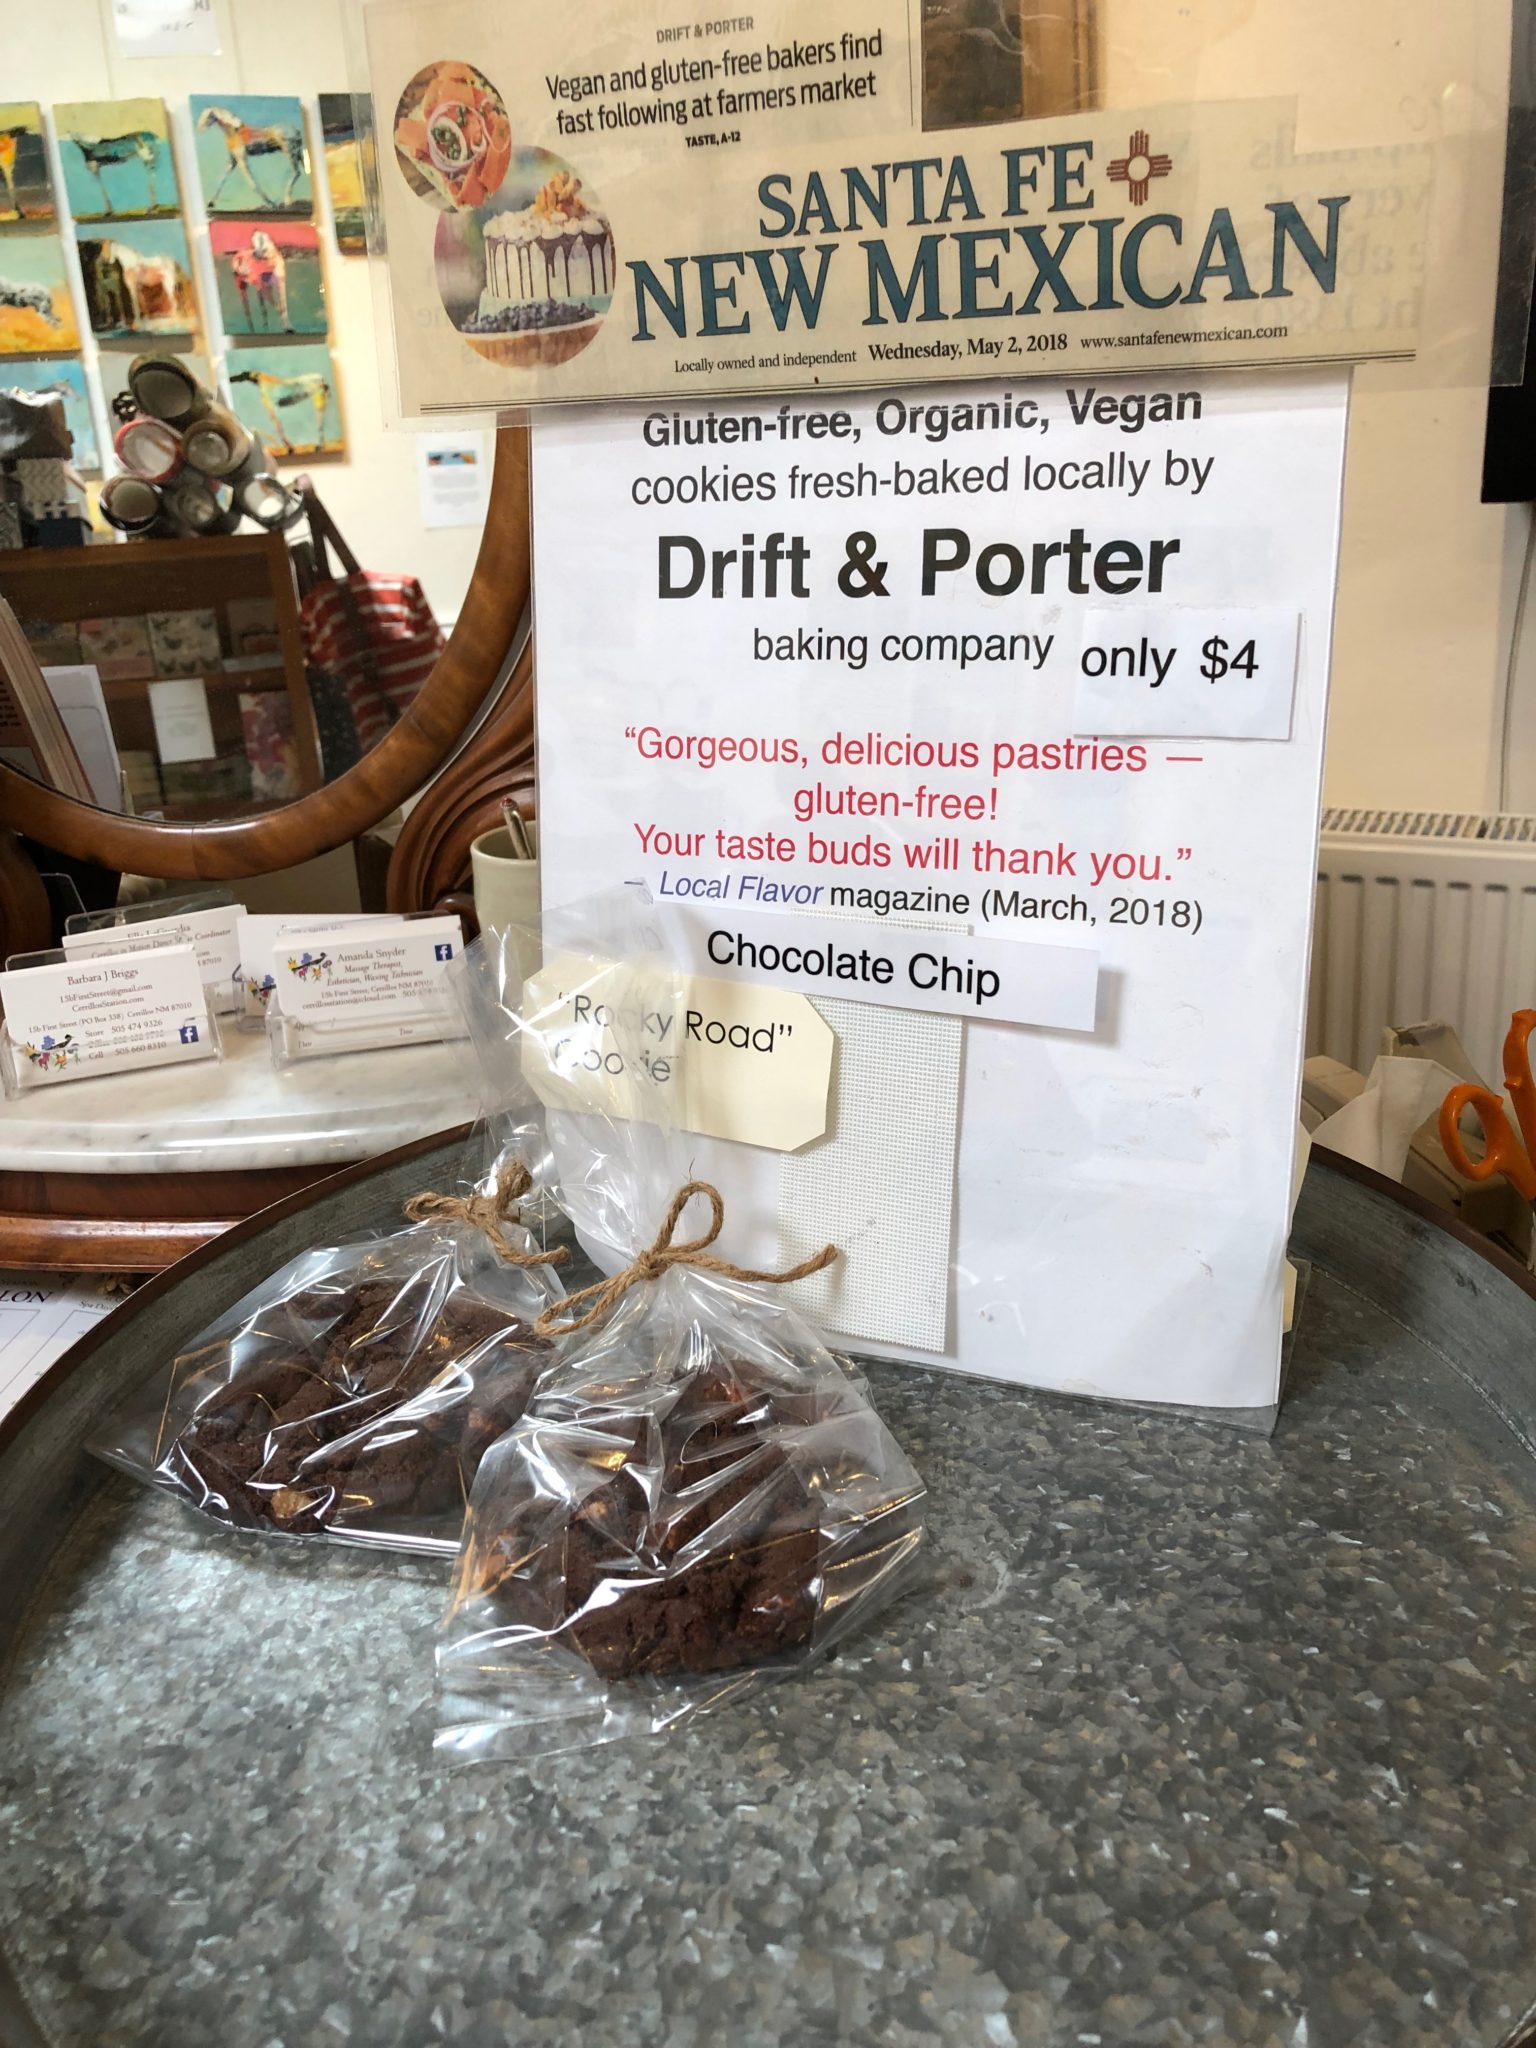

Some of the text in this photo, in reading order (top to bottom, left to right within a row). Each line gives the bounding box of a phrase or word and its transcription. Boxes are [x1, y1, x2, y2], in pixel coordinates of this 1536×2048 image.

[656, 16, 754, 43] DRIFT & PORTER
[546, 28, 883, 101] Vegan and gluten-free bakers find
[557, 70, 877, 135] fast following at farmers market
[686, 131, 741, 148] TASTE, A-12
[758, 140, 1095, 239] SANTA FE
[625, 243, 840, 342] NEW
[859, 196, 1351, 325] MEXICAN
[675, 324, 1288, 375] Locally owned and independent Wednesday, May 2, 2018 www.santafenewmexican.com
[642, 385, 1202, 447] Gluten-free, Organic, Vegan
[631, 449, 1214, 506] cookies fresh-baked locally by
[656, 527, 1181, 600] Drift & Porter
[753, 628, 1055, 672] baking company
[1081, 635, 1260, 689] only $4
[624, 726, 809, 771] “Gorgeous,
[822, 730, 980, 772] delicious
[992, 736, 1148, 778] pastries
[794, 785, 999, 825] gluten-free!
[634, 823, 1193, 884] Your taste buds will thank you.”
[659, 871, 731, 899] Local
[737, 875, 824, 906] Flavor
[830, 883, 970, 918] magazine
[981, 888, 1096, 926] (March,
[1110, 894, 1204, 933] 2018)
[67, 969, 138, 985] Barbara J Briggs
[337, 947, 406, 963] Amanda Snyder
[707, 929, 1000, 1003] Chocolate Chip
[85, 1029, 104, 1038] Store
[111, 1025, 126, 1034] 505
[128, 1022, 142, 1031] 474
[143, 1019, 163, 1029] 9326
[155, 1005, 169, 1014] NM
[686, 1010, 792, 1053] Road”
